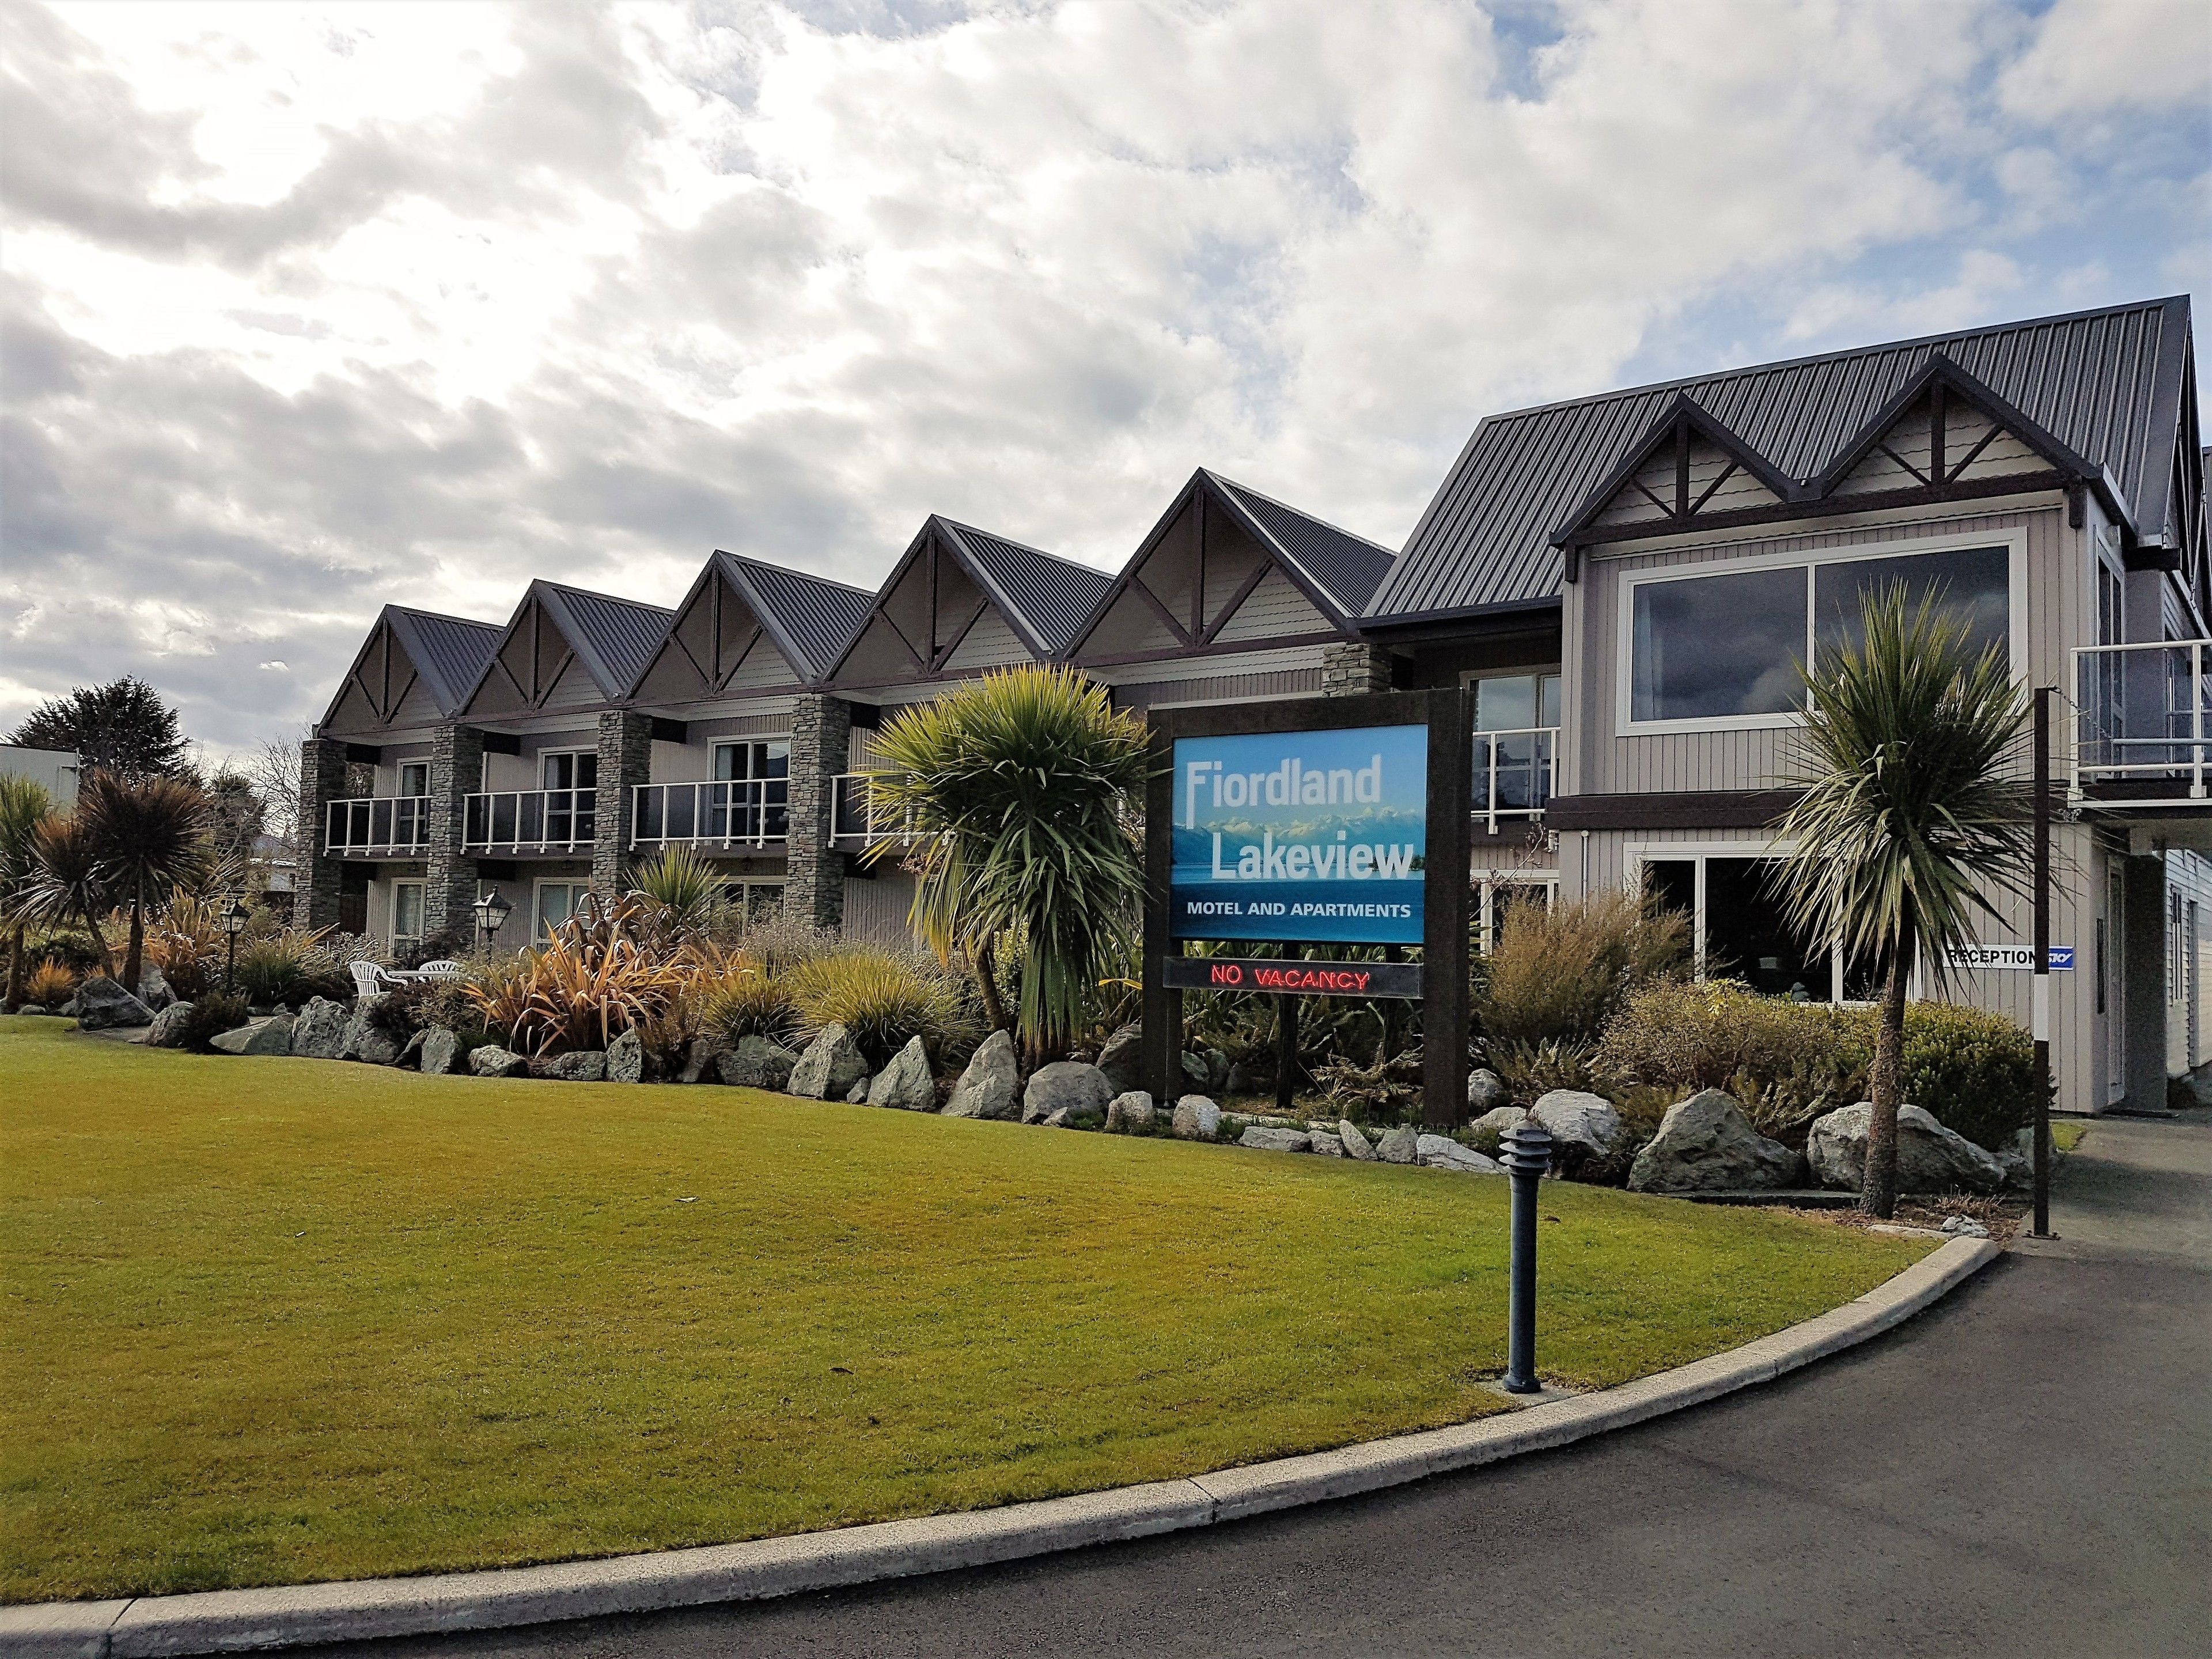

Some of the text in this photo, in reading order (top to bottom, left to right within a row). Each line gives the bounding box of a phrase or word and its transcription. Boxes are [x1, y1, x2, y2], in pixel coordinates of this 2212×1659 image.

[1186, 755, 1381, 830] Fiordland
[1212, 830, 1414, 879] Lakeview
[1187, 902, 1411, 918] MOTEL AND APARTMENTS
[1211, 964, 1370, 990] NO VACANCY
